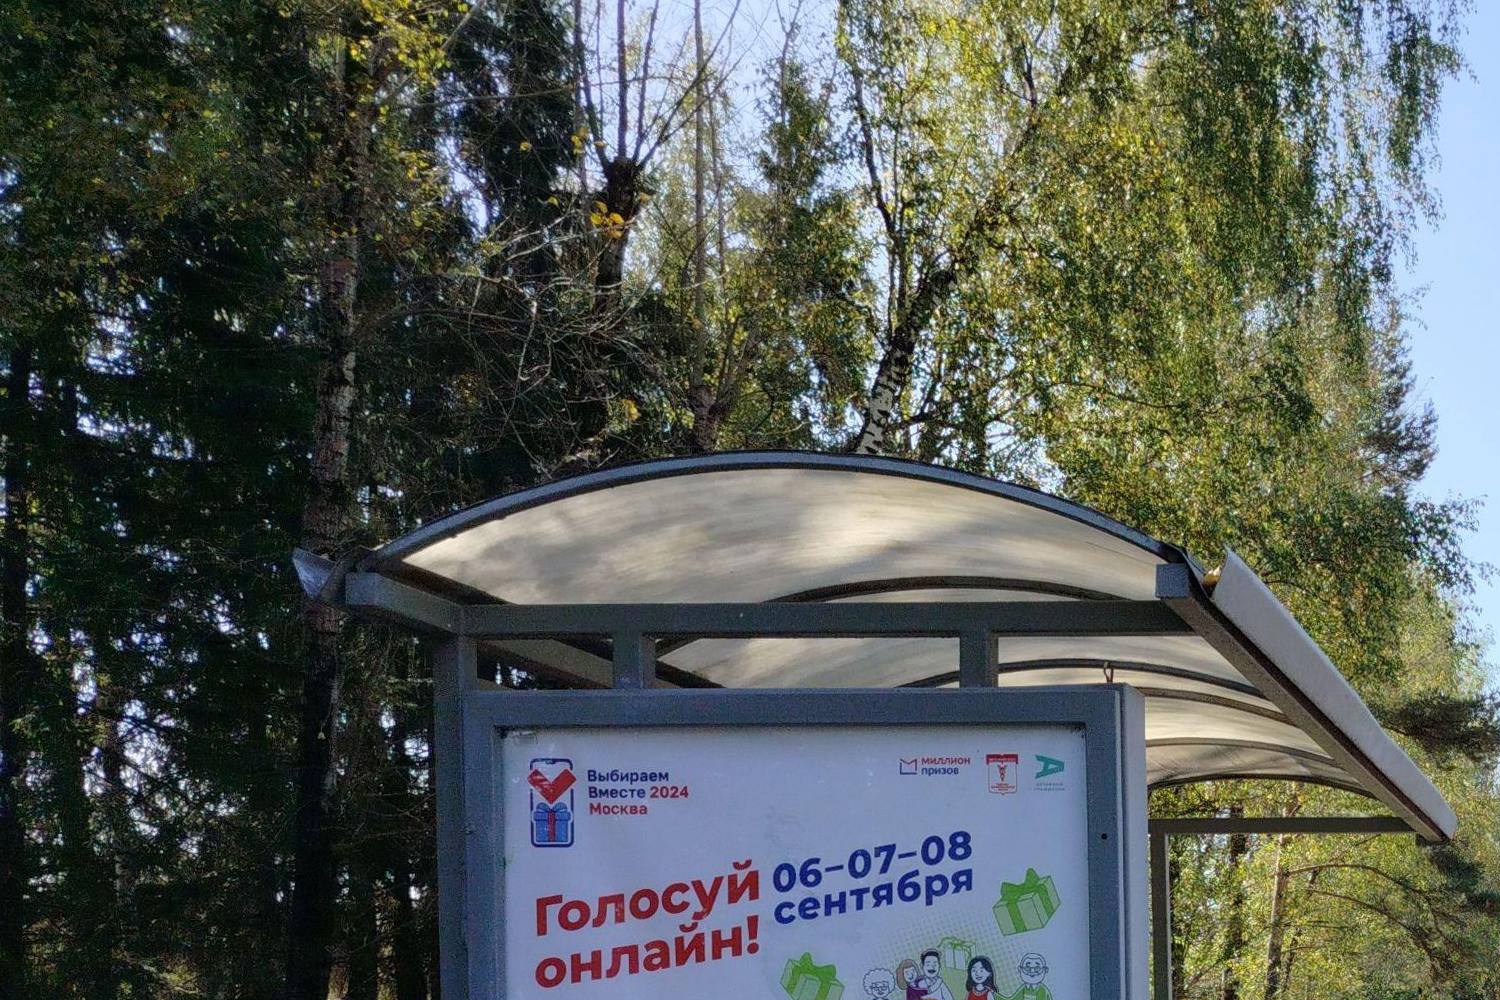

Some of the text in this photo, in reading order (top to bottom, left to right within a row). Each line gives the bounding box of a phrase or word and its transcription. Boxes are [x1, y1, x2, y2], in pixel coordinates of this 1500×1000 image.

[587, 769, 669, 783] Выбираем
[588, 785, 689, 799] Вместе 2024
[589, 803, 648, 815] Москва
[536, 859, 760, 936] Голосуй
[773, 868, 973, 925] сентября
[535, 915, 760, 988] онлайн!
